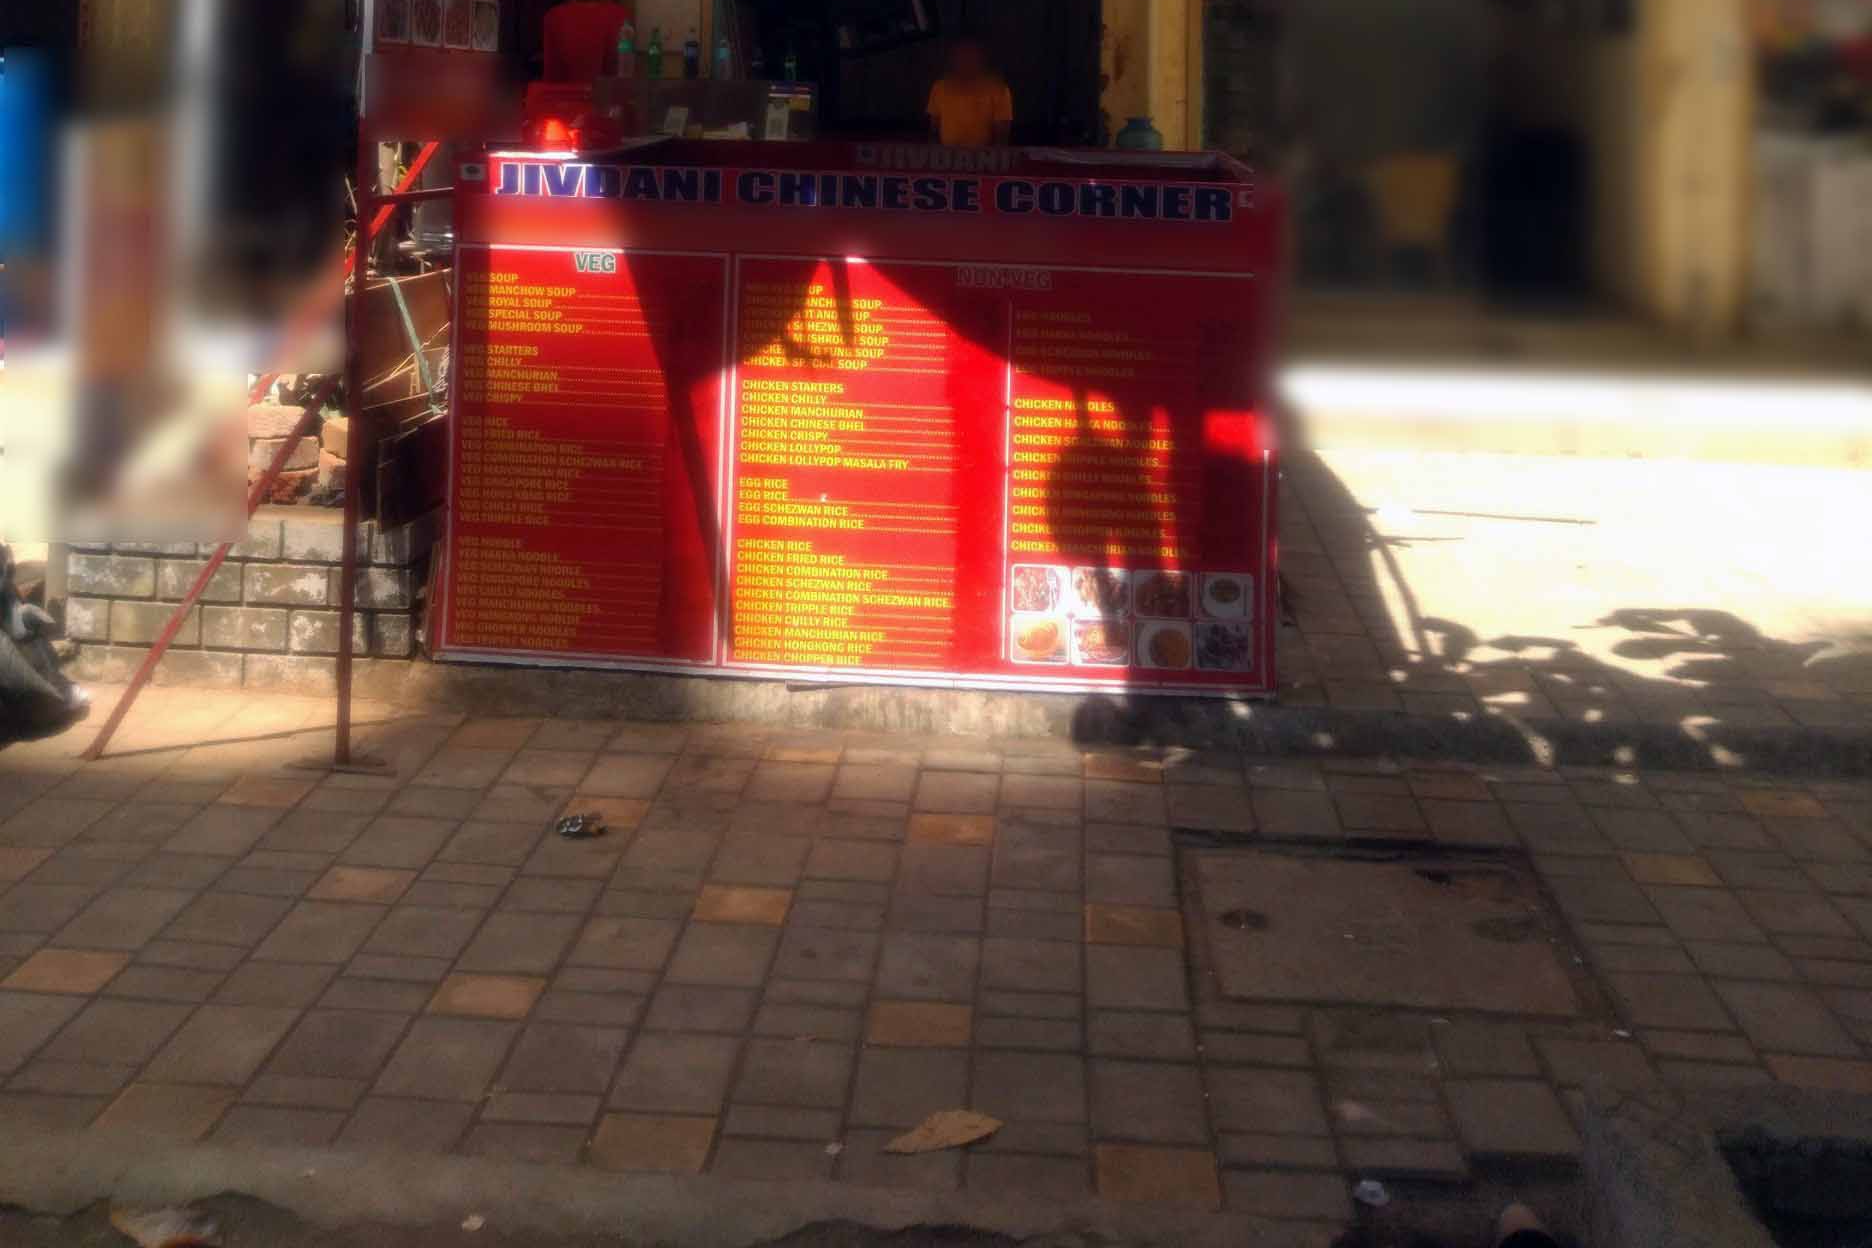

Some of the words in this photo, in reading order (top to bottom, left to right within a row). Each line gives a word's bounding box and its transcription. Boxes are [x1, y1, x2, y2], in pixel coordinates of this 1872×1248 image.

[495, 161, 723, 202] JIVDANI
[736, 168, 983, 214] CHINESE
[994, 179, 1233, 222] CORNER
[575, 252, 616, 273] VEG
[489, 272, 519, 283] SOUP
[488, 284, 544, 296] MANCHOW
[547, 287, 576, 297] SOUP
[488, 296, 521, 307] ROYAL
[524, 298, 552, 308] SOUP
[852, 299, 882, 310] SOUP
[488, 309, 531, 320] SPECIAL
[534, 311, 563, 321] SOUP
[487, 320, 551, 332] MUSHROOM
[554, 323, 583, 334] SOUP
[854, 324, 883, 334] SOUP
[860, 336, 889, 347] SOUP
[487, 345, 539, 356] STARTERS
[855, 349, 885, 359] SOUP
[487, 357, 522, 367] CHILLY
[838, 360, 868, 371] SOUP
[742, 379, 789, 391] CHICKEN
[791, 382, 844, 393] STARTERS
[742, 392, 788, 403] CHICKEN
[791, 393, 827, 404] CHILLY
[1014, 398, 1062, 410] CHICKEN
[741, 404, 788, 416] CHICKEN
[791, 406, 864, 419] MANCHURIAN
[741, 417, 787, 428] CHICKEN
[790, 418, 838, 430] CHINESE
[1014, 415, 1062, 427] CHICKEN
[741, 429, 787, 440] CHICKEN
[789, 430, 828, 441] CRISPY
[1013, 433, 1062, 445] CHICKEN
[740, 441, 786, 452] CHICKEN
[789, 442, 841, 454] LOLLYPOP
[740, 453, 787, 465] CHICKEN
[789, 455, 841, 467] LOLLYPOP
[843, 458, 886, 470] MASALA
[888, 460, 910, 471] FRY
[1013, 451, 1061, 463] CHICKEN
[739, 477, 761, 488] EGG
[763, 478, 789, 489] RICE
[739, 490, 761, 501] EGG
[763, 490, 789, 501] RICE
[739, 502, 761, 513] EGG
[763, 504, 821, 516] SCHEZWAN
[823, 506, 849, 517] RICE
[738, 514, 761, 525] EGG
[762, 515, 838, 528] COMBINATION
[839, 519, 865, 529] RICE
[737, 538, 784, 550] CHICKEN
[787, 540, 813, 551] RICE
[1011, 539, 1058, 552] CHICKEN
[737, 551, 784, 562] CHICKEN
[786, 553, 817, 564] FRIED
[819, 554, 845, 565] RICE
[737, 563, 784, 575] CHICKEN
[786, 565, 861, 578] COMBINATION
[863, 568, 889, 579] RICE
[736, 576, 783, 587] CHICKEN
[785, 577, 845, 590] SCHEZWAN
[847, 580, 873, 591] RICE
[736, 588, 783, 600] CHICKEN
[785, 589, 860, 603] COMBINATION
[862, 594, 921, 606] SCHEZWAN
[924, 597, 950, 608] RICE
[736, 600, 782, 611] CHICKEN
[784, 602, 827, 614] TRIPPLE
[829, 605, 855, 615] RICE
[736, 613, 782, 624] CHICKEN
[822, 617, 848, 628] RICE
[735, 625, 782, 637] CHICKEN
[784, 627, 858, 640] MANCHURIAN
[859, 630, 886, 641] RICE
[735, 638, 781, 649] CHICKEN
[784, 639, 844, 653] HONGKONG
[847, 642, 873, 653] RICE
[734, 650, 781, 661] CHICKEN
[784, 652, 833, 665] CHOPPER
[835, 655, 862, 665] RICE
